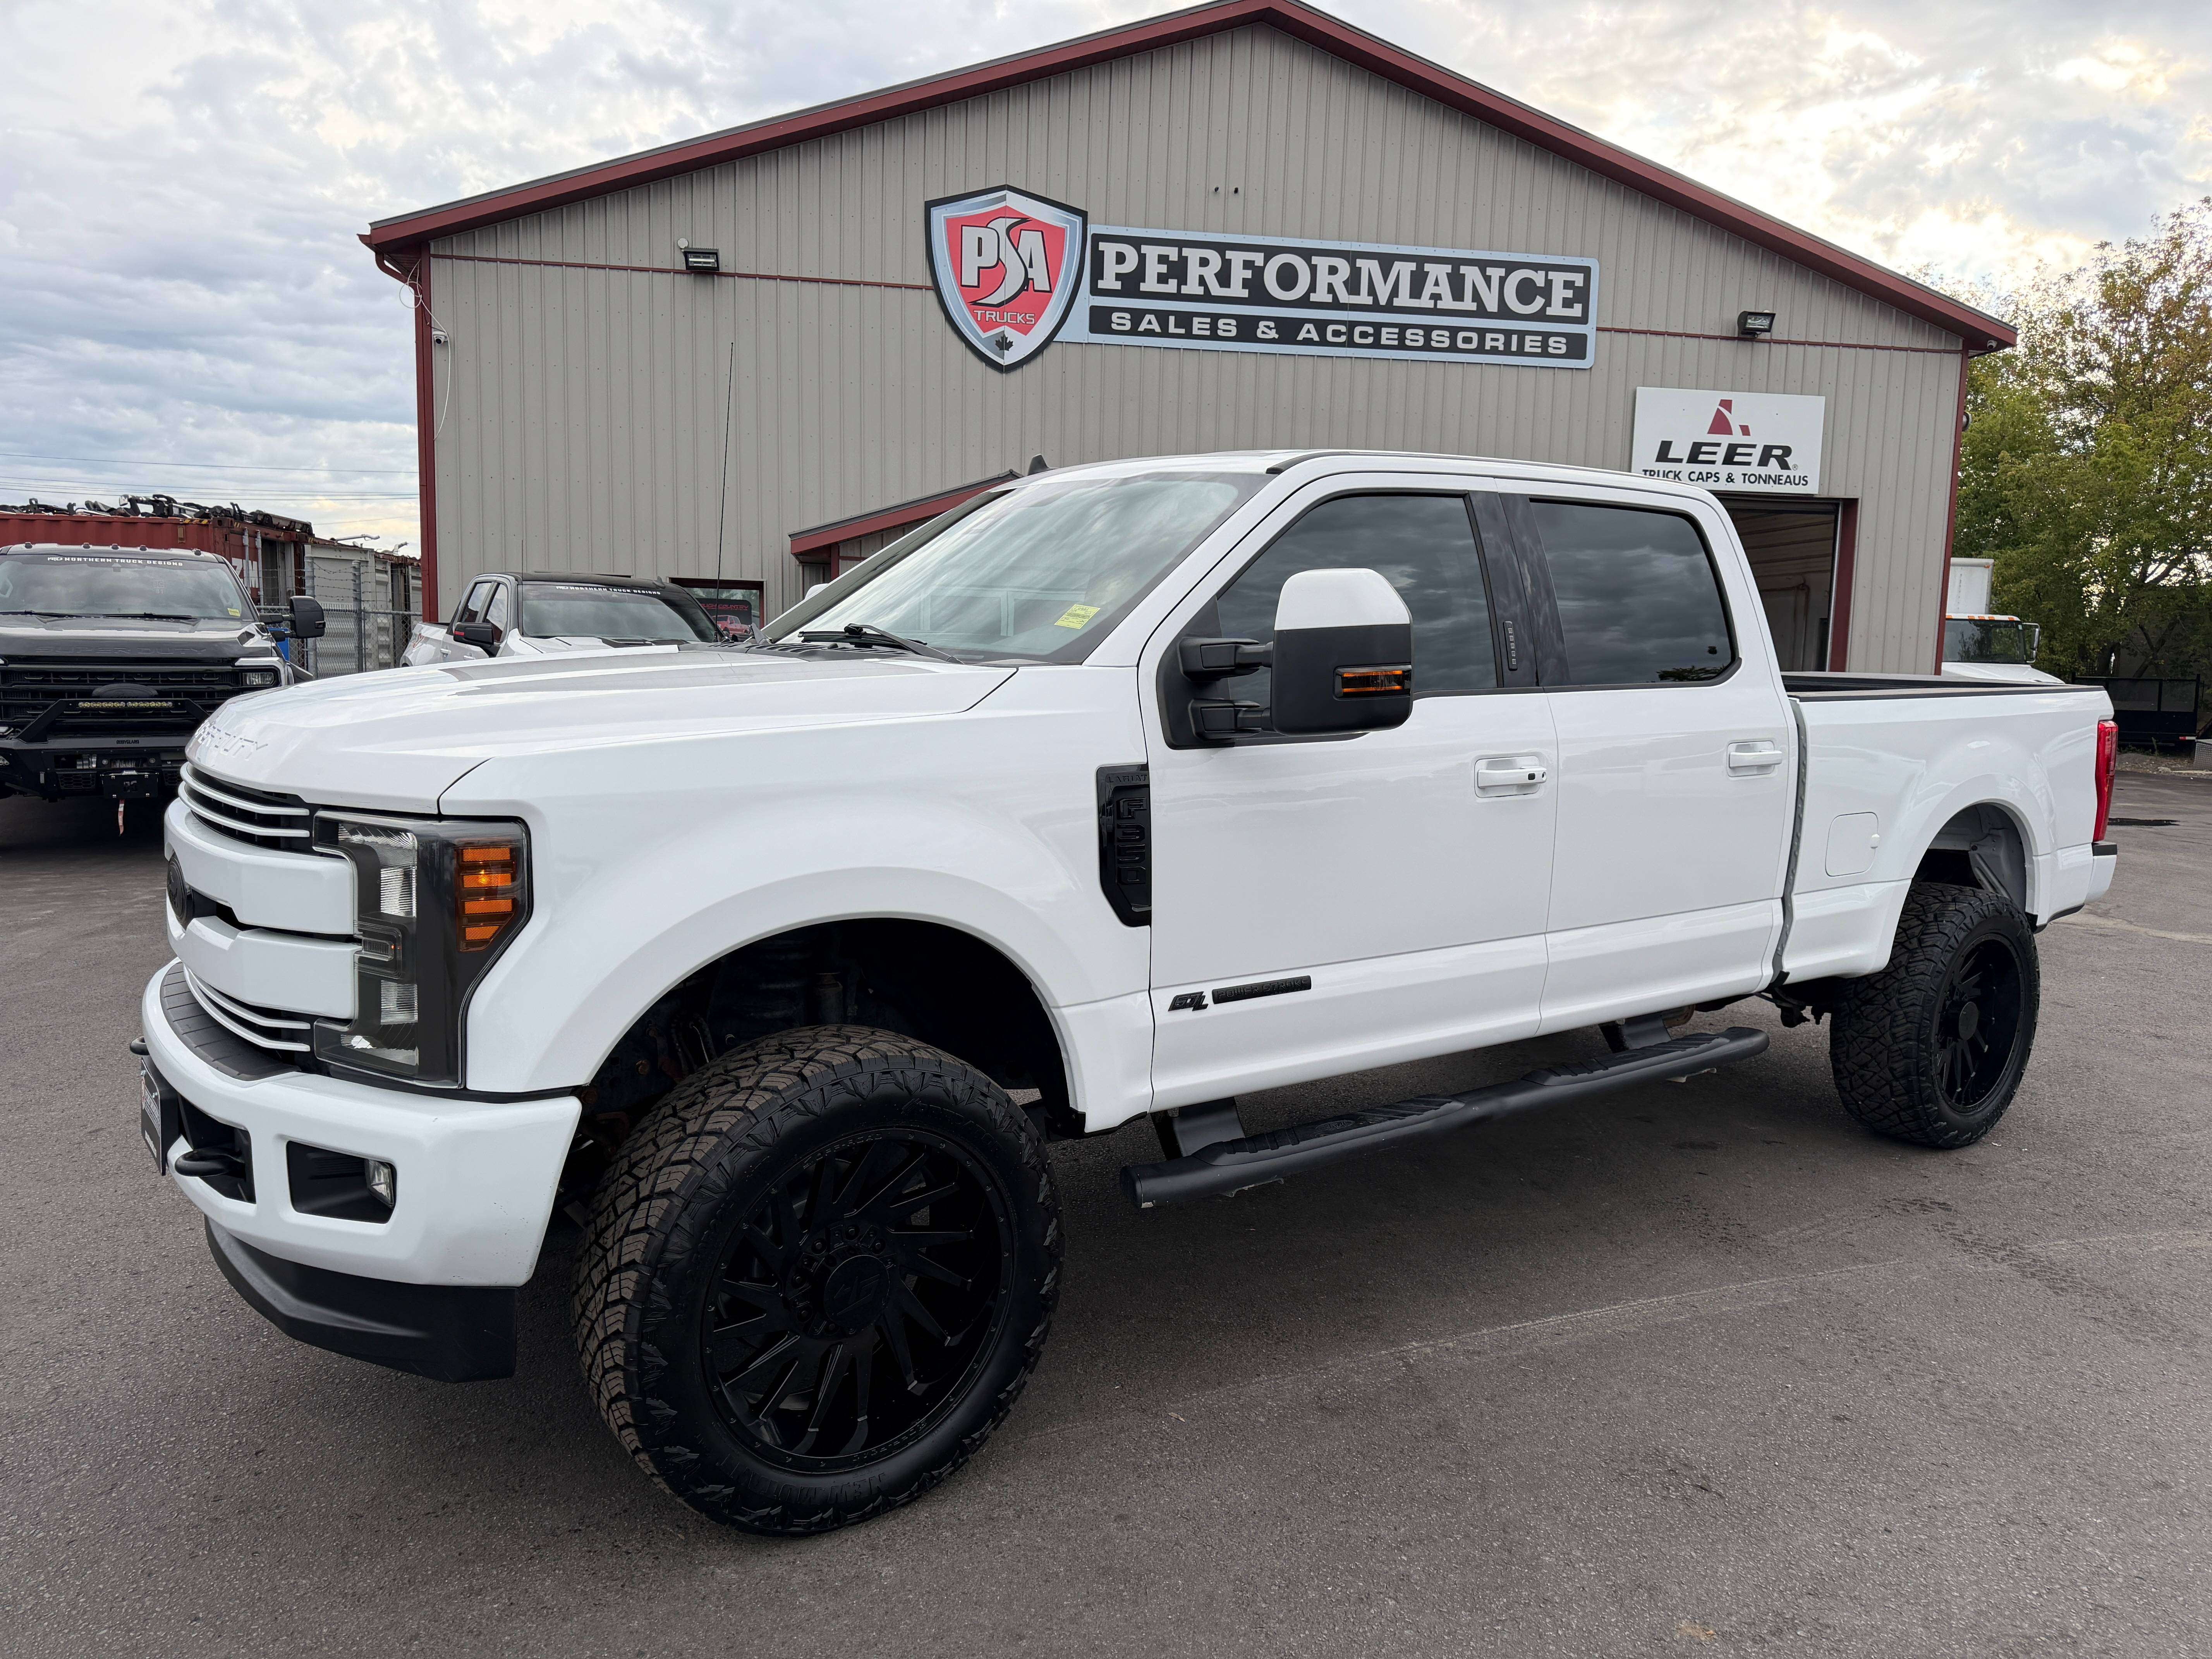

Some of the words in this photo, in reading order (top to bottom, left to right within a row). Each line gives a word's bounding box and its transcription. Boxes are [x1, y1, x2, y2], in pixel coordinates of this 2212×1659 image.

[961, 217, 1052, 307] PSA
[1097, 240, 1583, 318] PERFORMANCE
[973, 310, 1035, 324] TRUCKS
[1110, 313, 1238, 338] SALES
[1256, 321, 1279, 339] &
[1296, 323, 1567, 354] ACCESSORIES
[1655, 440, 1793, 471] LEER
[1688, 471, 1720, 483] CAPS
[1726, 472, 1735, 483] &
[1742, 473, 1808, 486] TONNEAUS
[1109, 774, 1147, 783] LARIAT
[1218, 986, 1259, 999] POWER
[1263, 979, 1309, 993] STROKE
